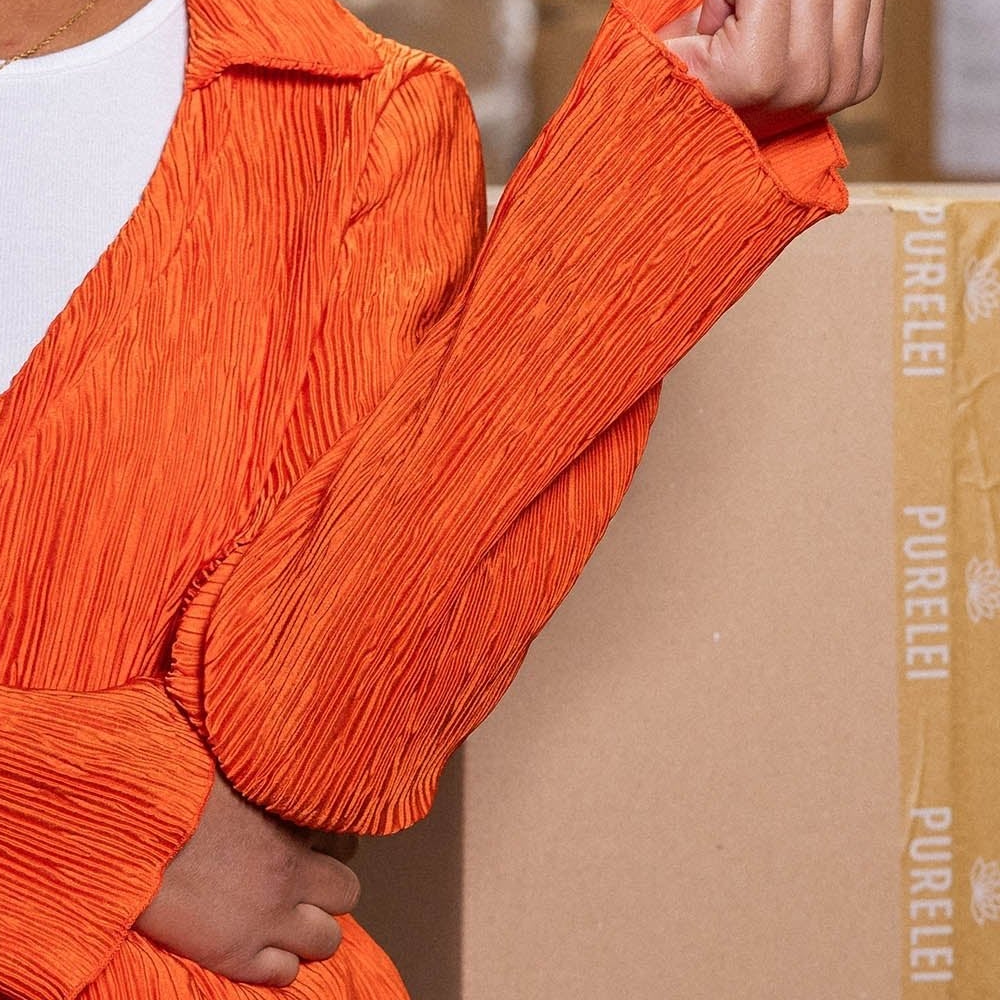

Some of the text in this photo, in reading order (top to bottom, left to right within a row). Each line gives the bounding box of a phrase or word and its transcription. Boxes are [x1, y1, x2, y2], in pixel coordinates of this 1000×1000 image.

[903, 204, 947, 377] PURELEI
[903, 505, 950, 679] PURELEI
[909, 806, 954, 983] PURELEI
